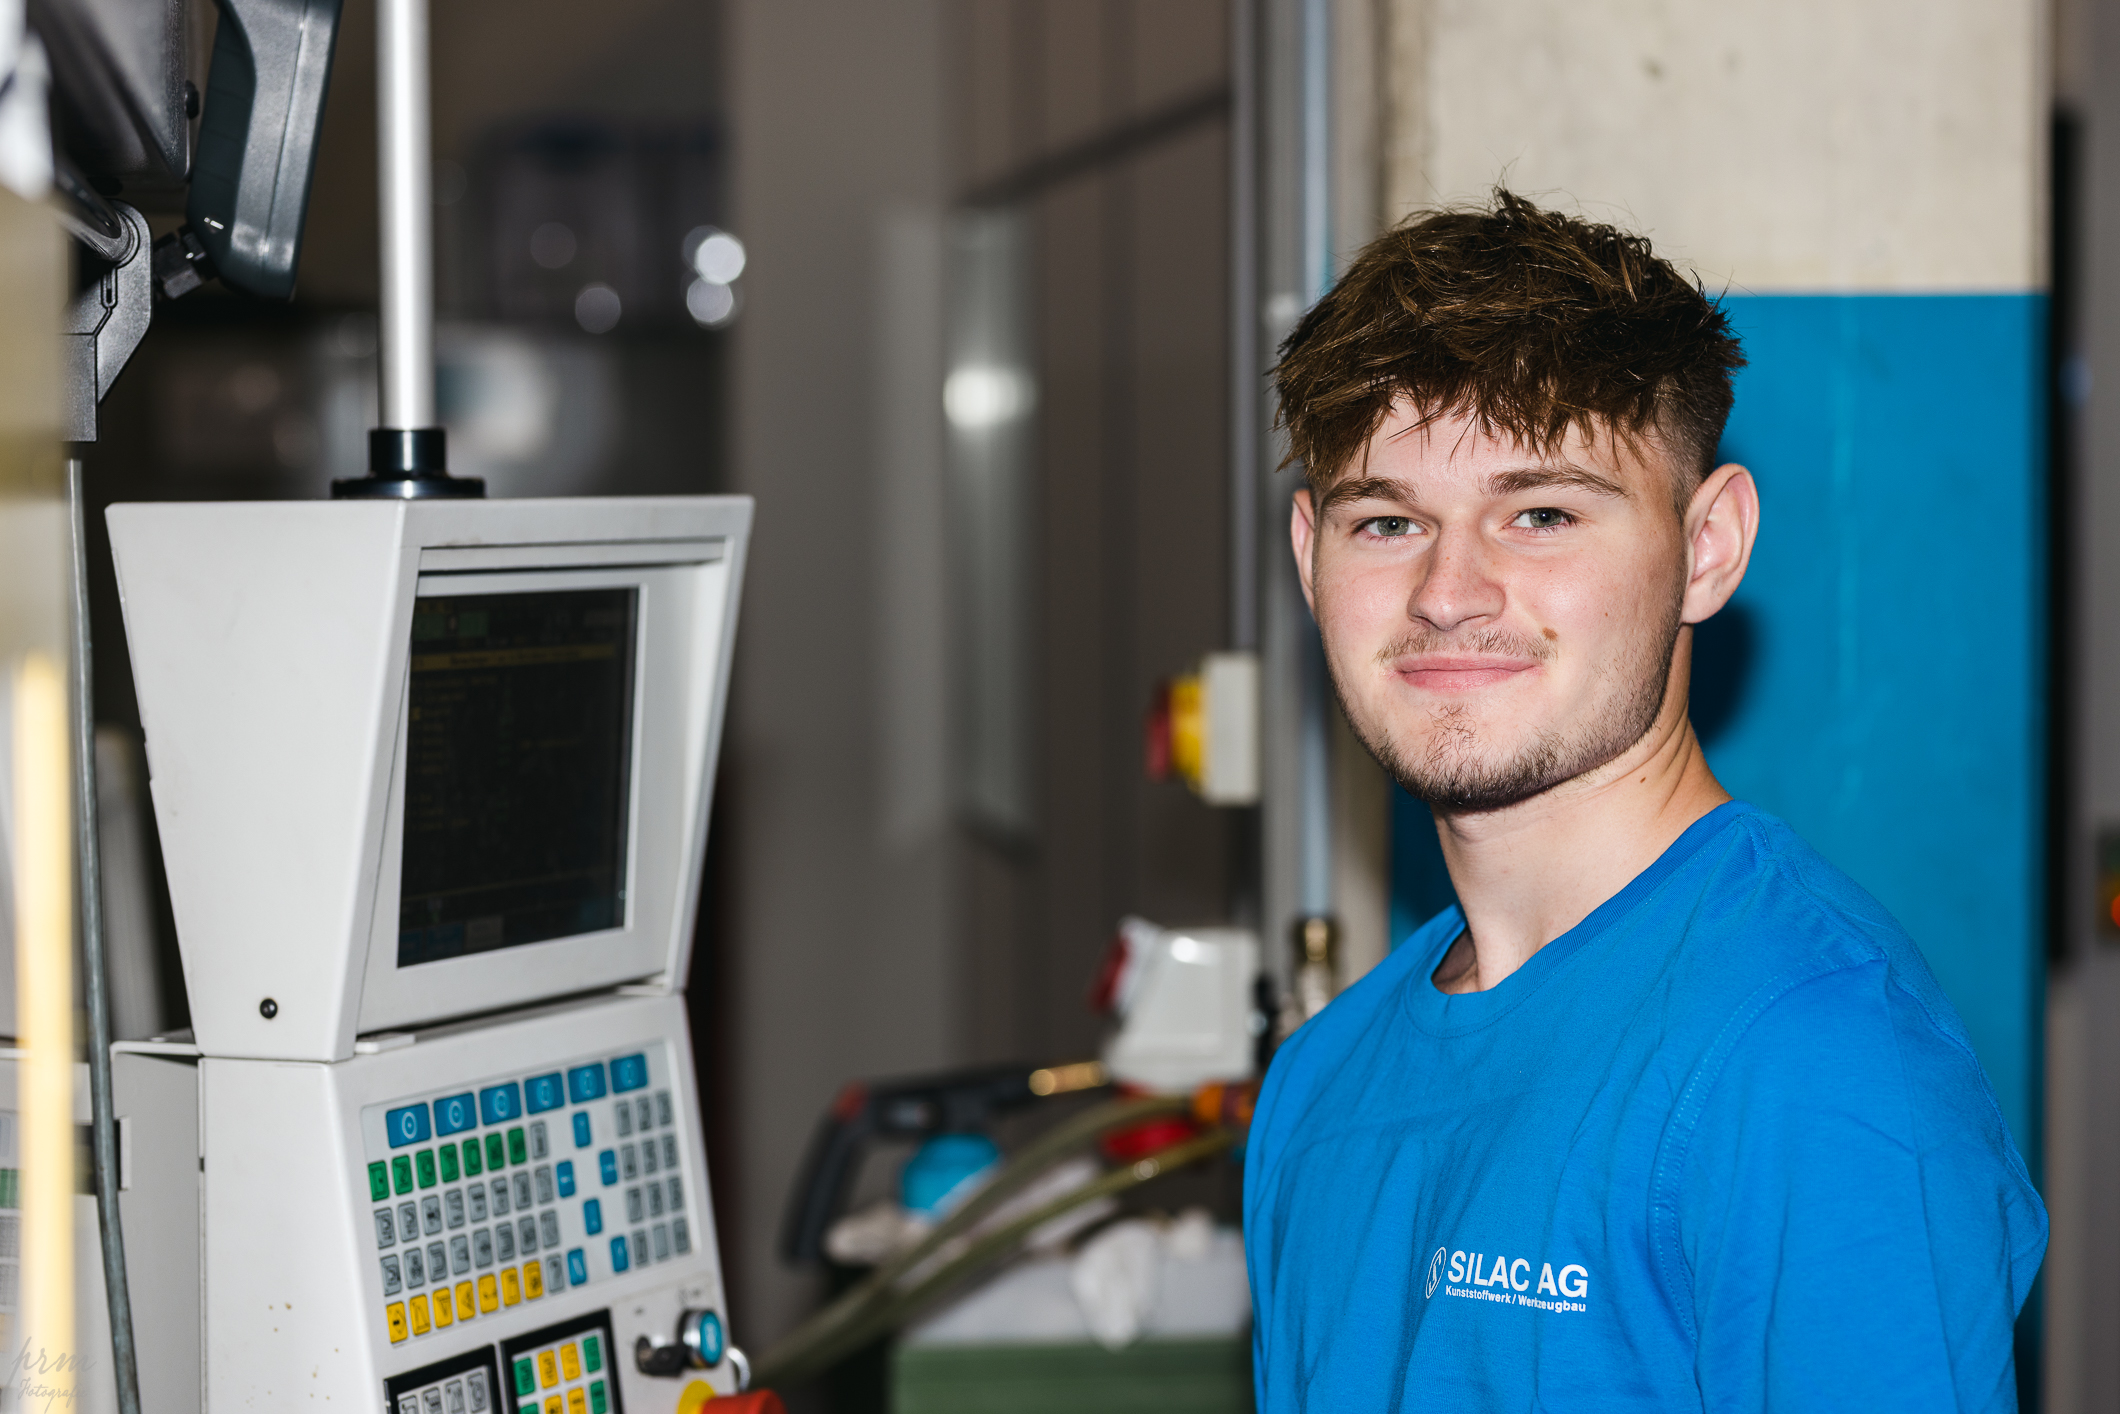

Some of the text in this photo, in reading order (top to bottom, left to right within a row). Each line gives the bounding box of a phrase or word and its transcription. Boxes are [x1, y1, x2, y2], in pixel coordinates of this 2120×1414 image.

[1448, 1250, 1588, 1298] SILAC AG
[1445, 1284, 1511, 1305] Kunststoffwerk
[1518, 1294, 1587, 1314] Werkzeugbau
